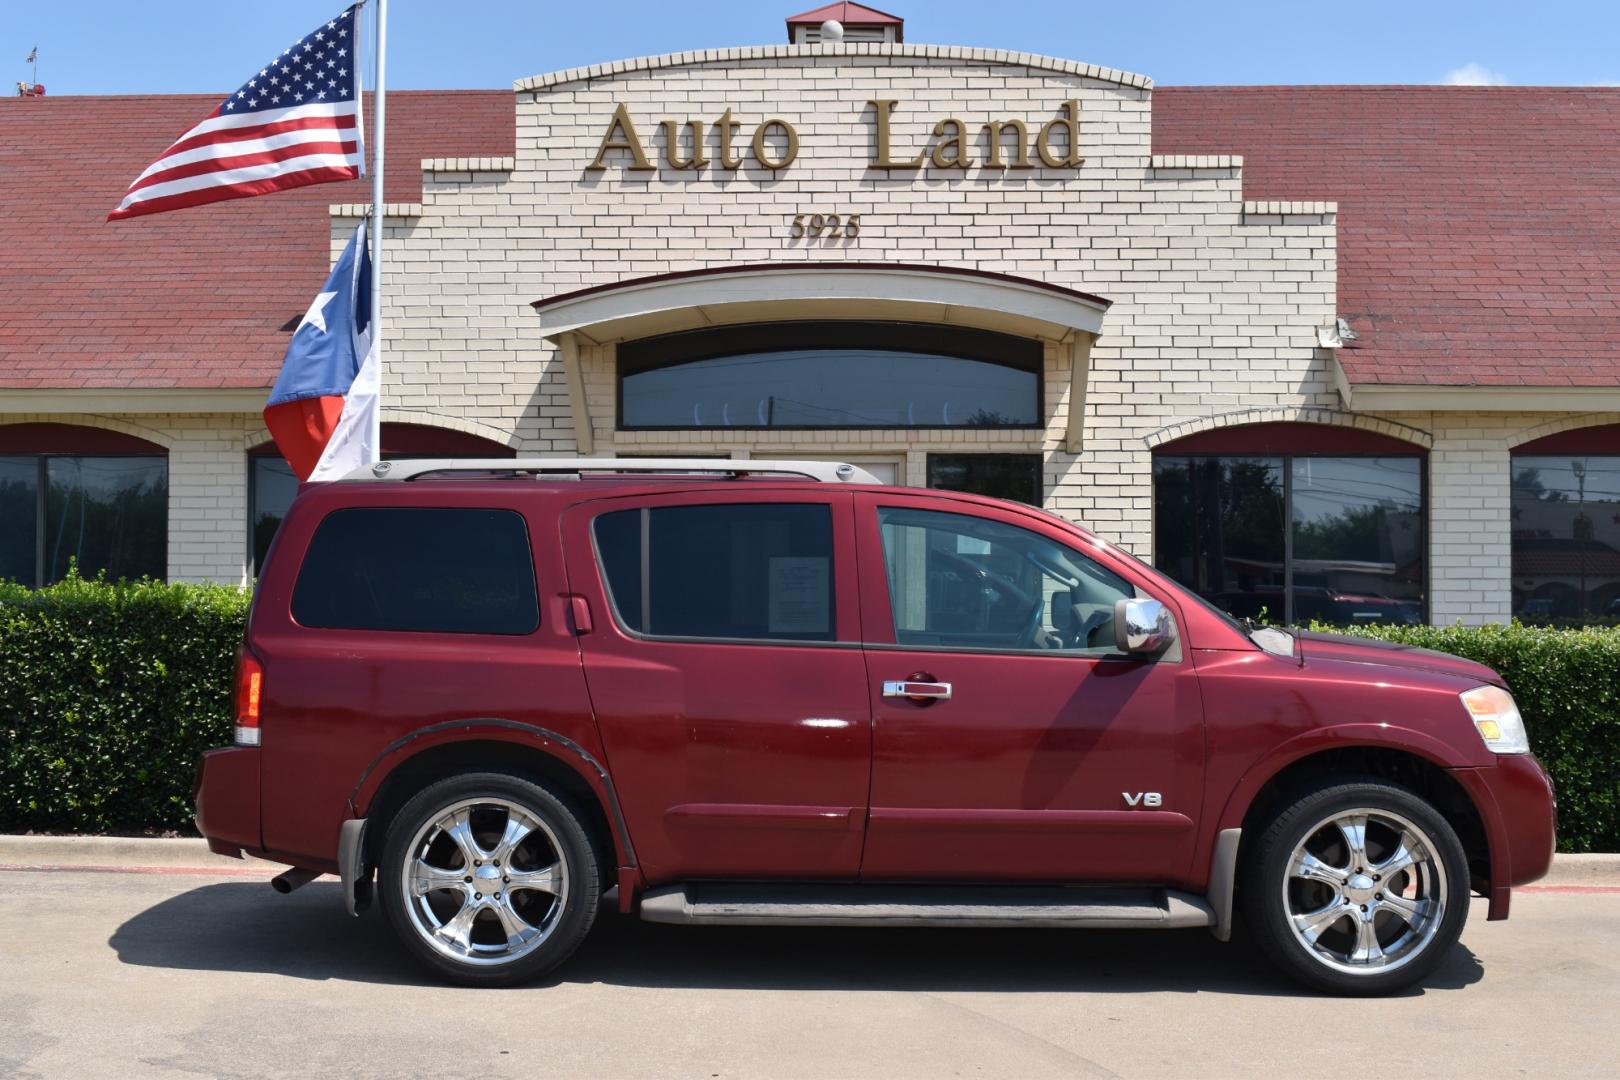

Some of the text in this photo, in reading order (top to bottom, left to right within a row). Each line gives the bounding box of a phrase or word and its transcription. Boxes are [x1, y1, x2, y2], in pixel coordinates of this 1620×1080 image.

[586, 98, 1086, 171] Auto Land
[791, 213, 861, 239] 5925
[1121, 792, 1162, 807] V8
